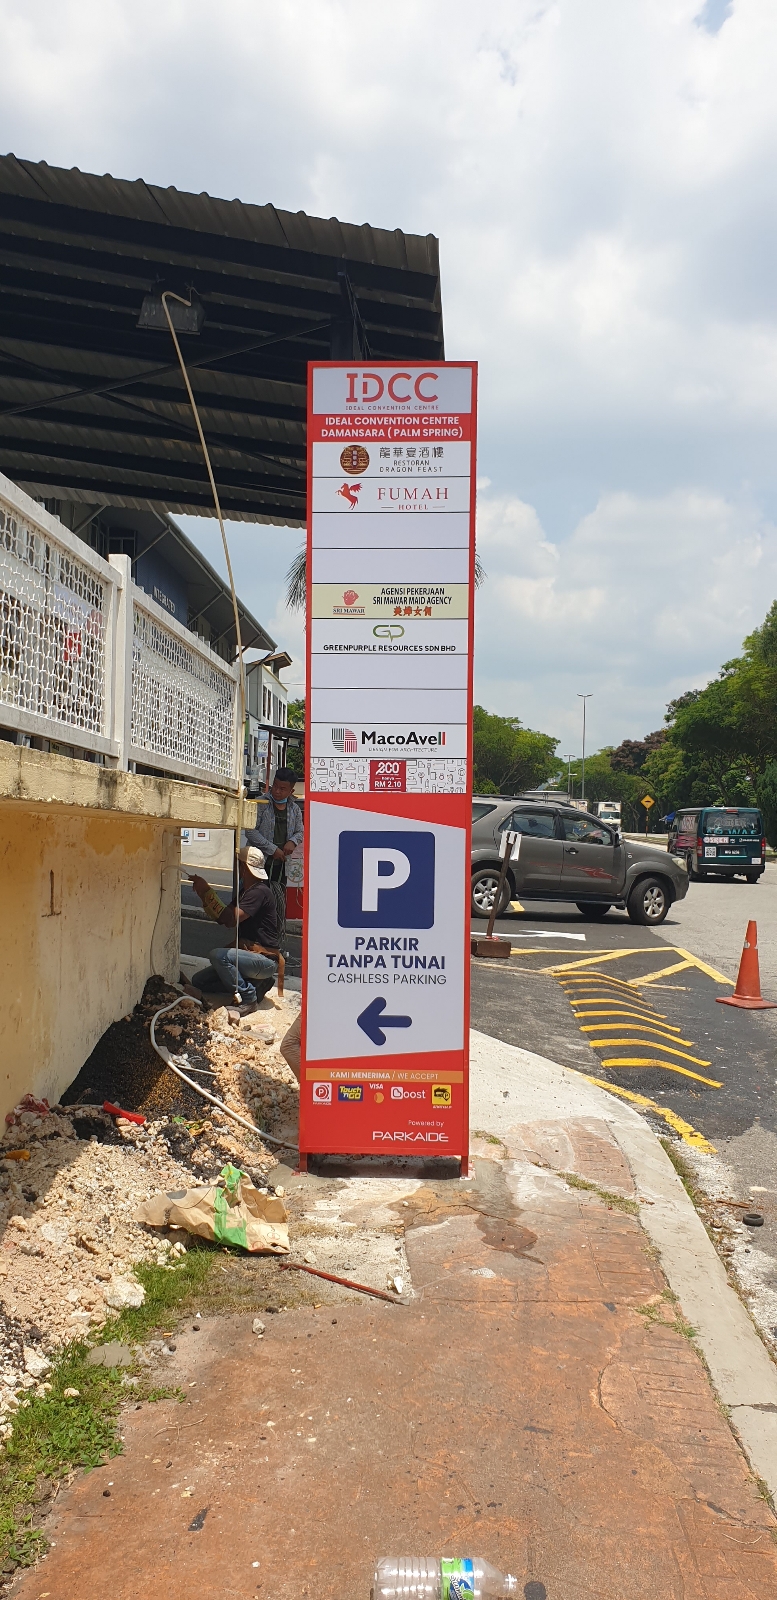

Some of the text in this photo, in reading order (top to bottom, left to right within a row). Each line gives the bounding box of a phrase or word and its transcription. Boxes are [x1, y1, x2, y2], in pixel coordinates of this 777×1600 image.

[345, 372, 439, 403] IDCC
[325, 416, 459, 426] IDEAL CONVENTION CENTRE
[321, 428, 385, 437] DAMANSARA
[422, 426, 463, 438] SPRING)
[377, 487, 449, 500] FUMAH
[381, 587, 445, 596] AGENSI PEKERJAAN
[372, 596, 452, 605] SRI MAWAR MAID AGENCY
[323, 644, 377, 652] GREENPURPLE
[361, 730, 446, 746] MacoAvell
[361, 847, 411, 912] P
[354, 936, 419, 951] PARKIR
[326, 954, 445, 970] TANPA TUNAI
[327, 973, 447, 985] CASHLESS PARKING
[330, 1071, 350, 1079] KAMI
[397, 1072, 409, 1080] WE
[409, 1072, 439, 1080] ACCEPT
[372, 1131, 449, 1142] PARKAIDE
